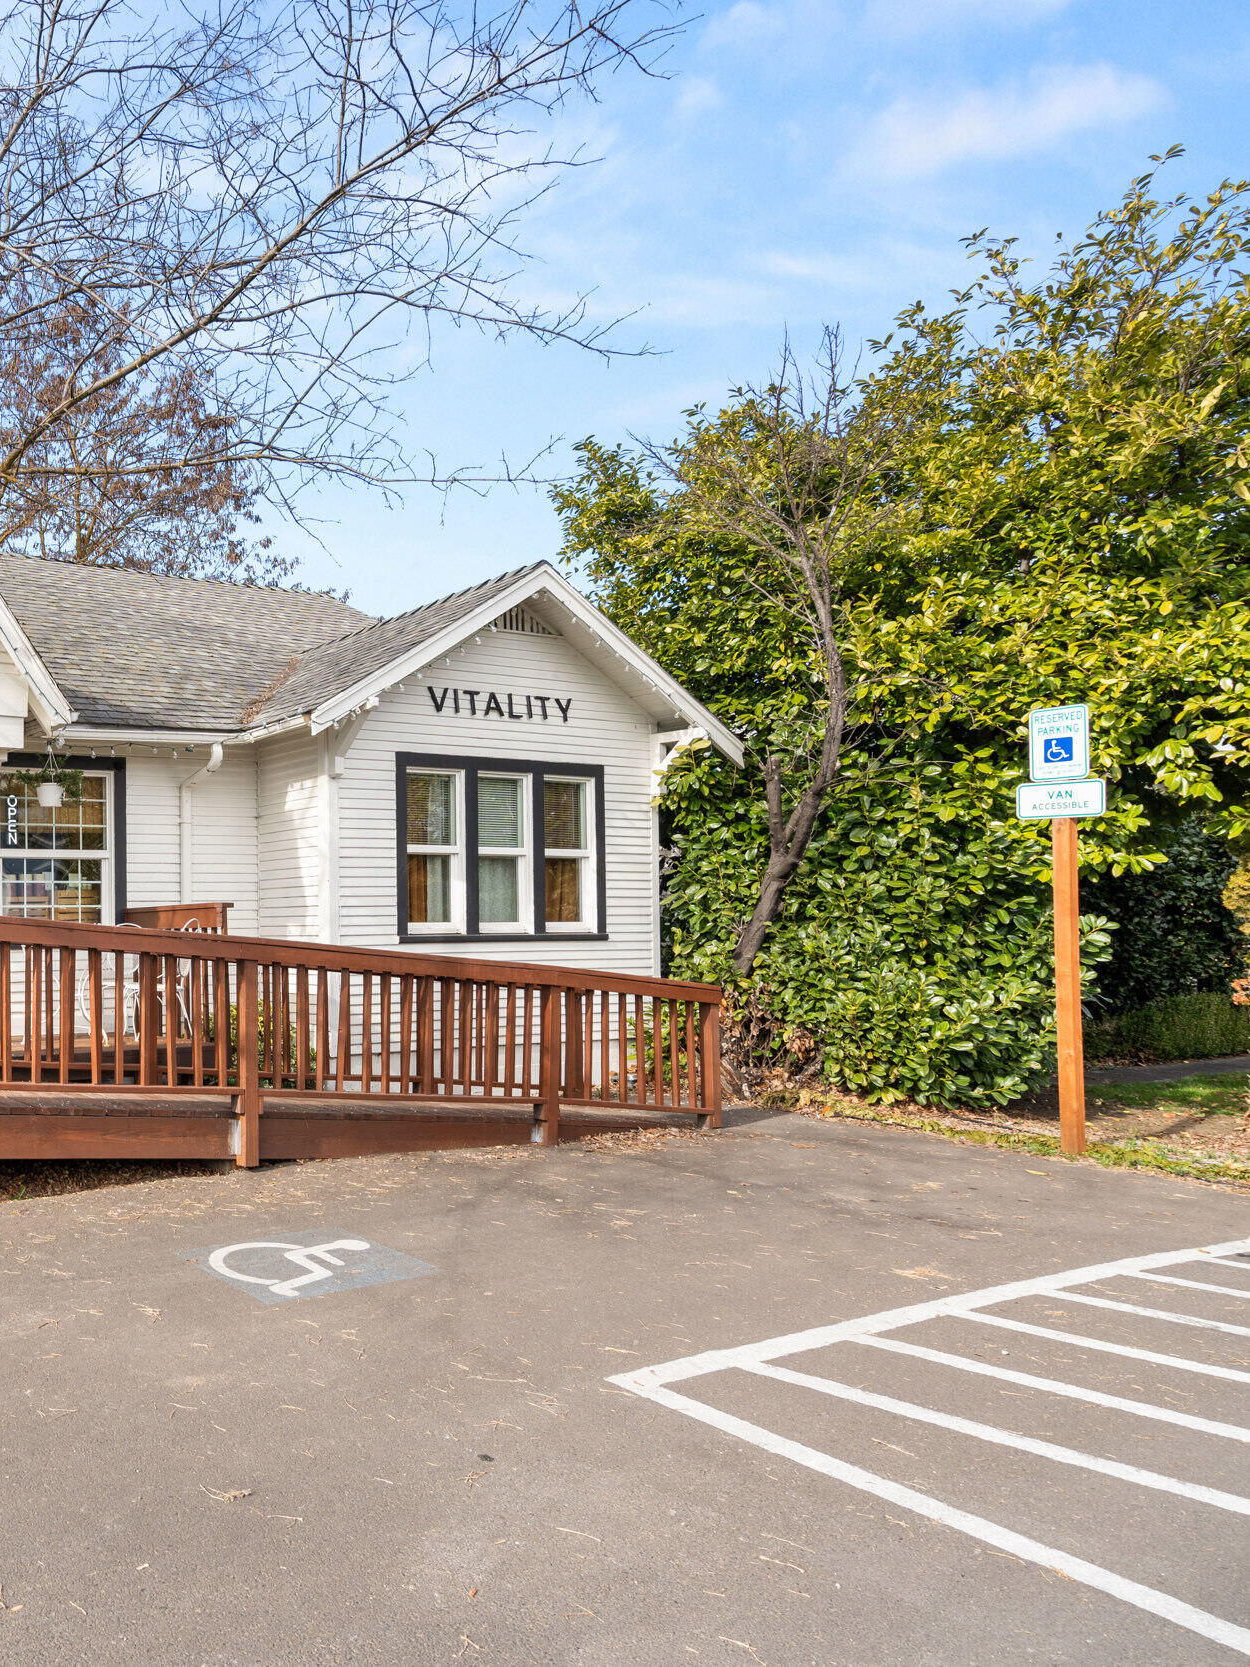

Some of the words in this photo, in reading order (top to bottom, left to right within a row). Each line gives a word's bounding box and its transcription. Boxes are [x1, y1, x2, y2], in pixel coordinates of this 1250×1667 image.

[427, 686, 573, 723] VITALITY
[1034, 710, 1083, 725] RESERVED
[1037, 724, 1080, 737] PARKING
[1047, 790, 1073, 799] VAN
[1032, 800, 1090, 811] ACCESSIBLE
[7, 794, 18, 845] OPEN
